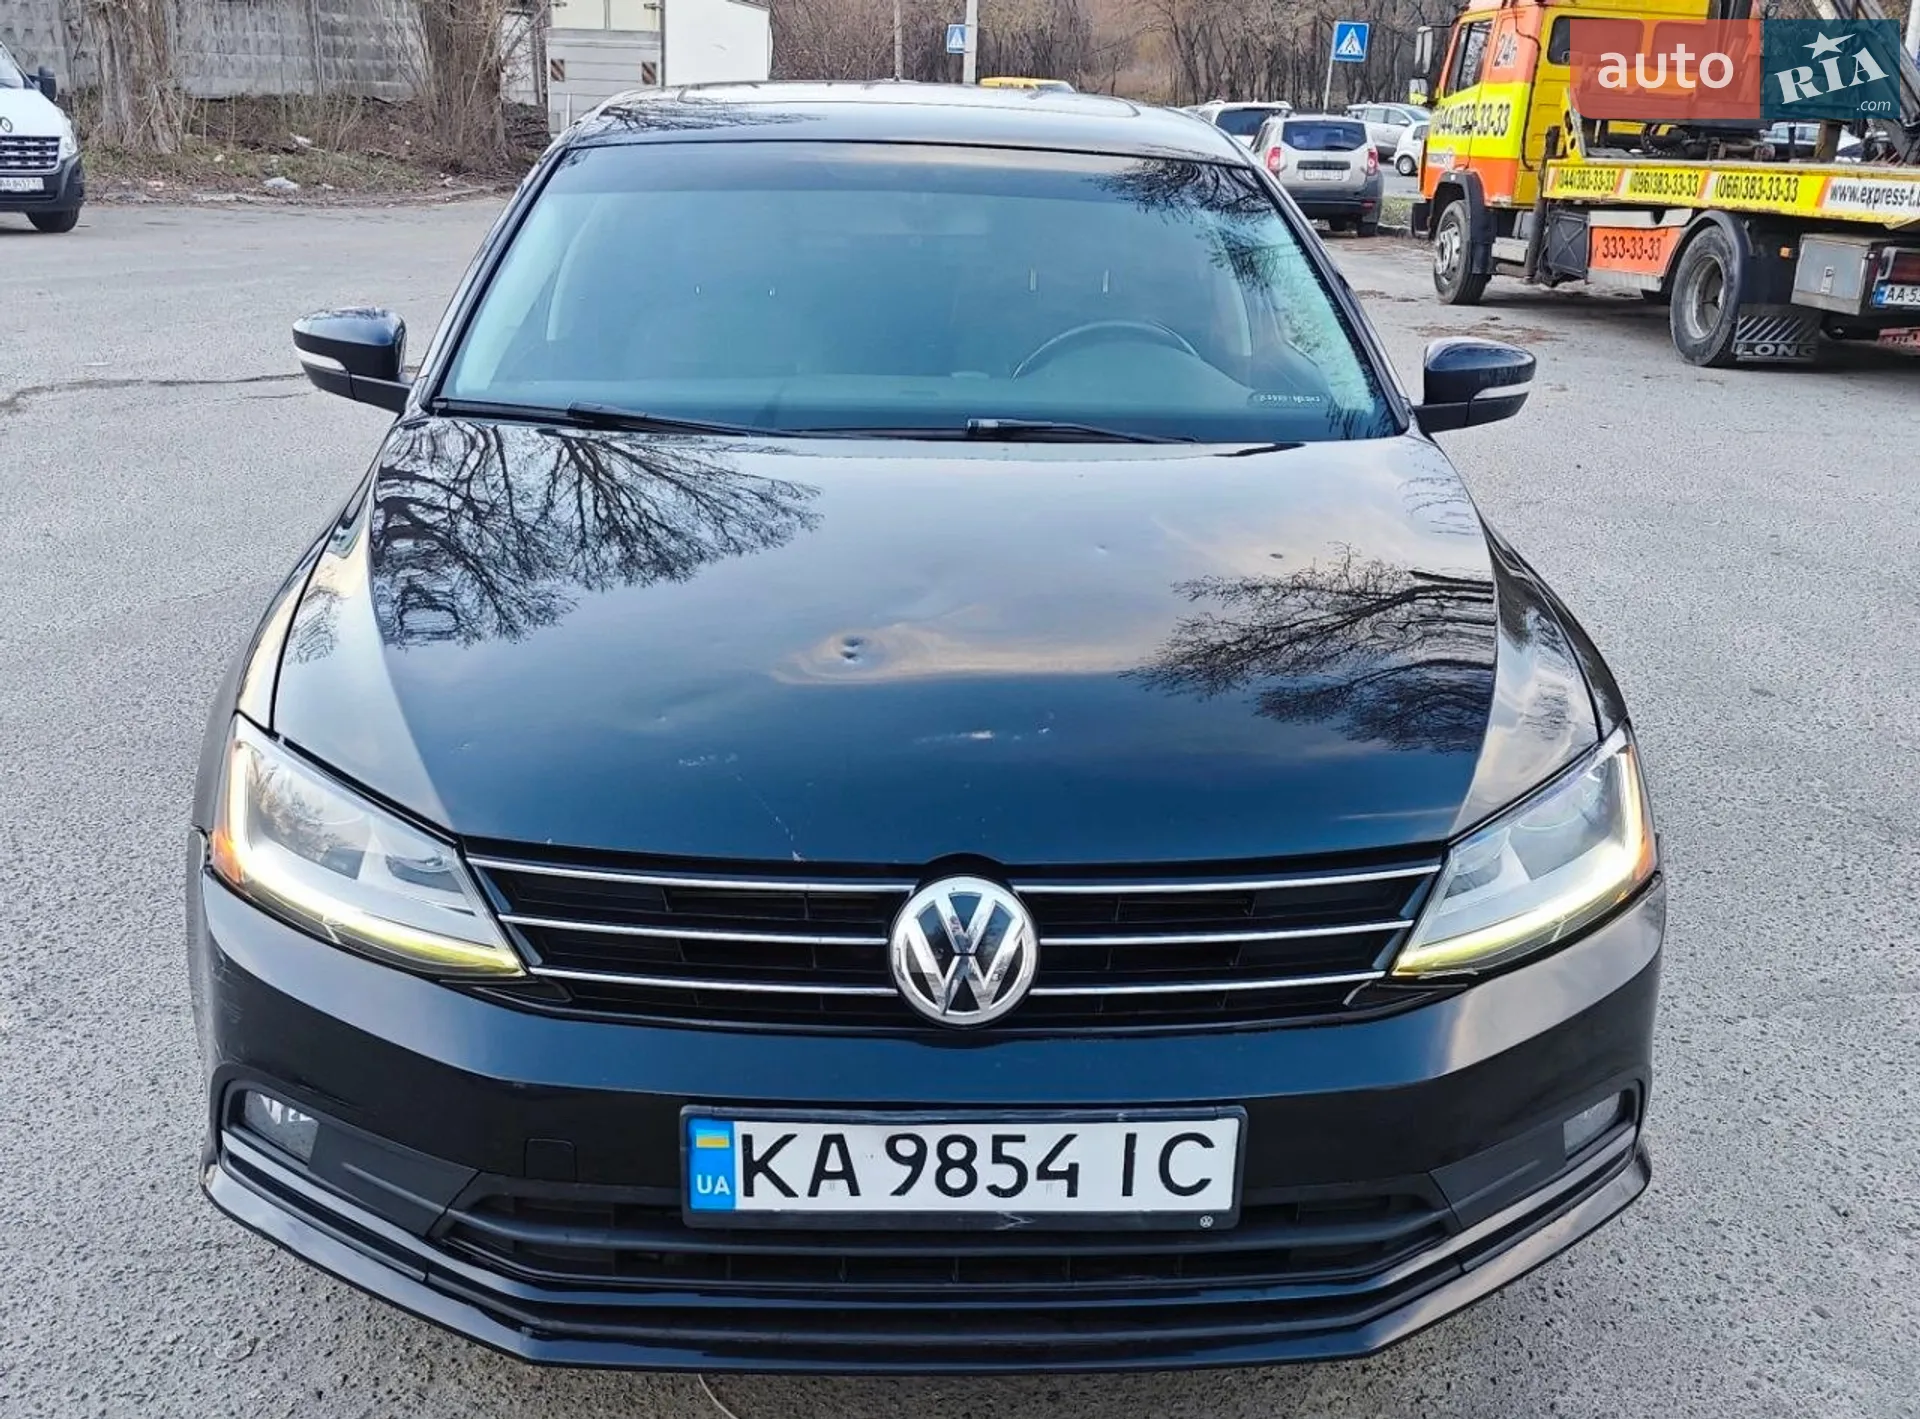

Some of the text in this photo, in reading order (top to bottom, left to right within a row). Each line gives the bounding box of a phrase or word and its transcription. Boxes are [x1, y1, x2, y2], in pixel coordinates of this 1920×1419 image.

[1715, 174, 1800, 203] (066)383-33-33
[741, 1132, 1216, 1198] KA 9854 IC
[697, 1174, 731, 1195] UA
